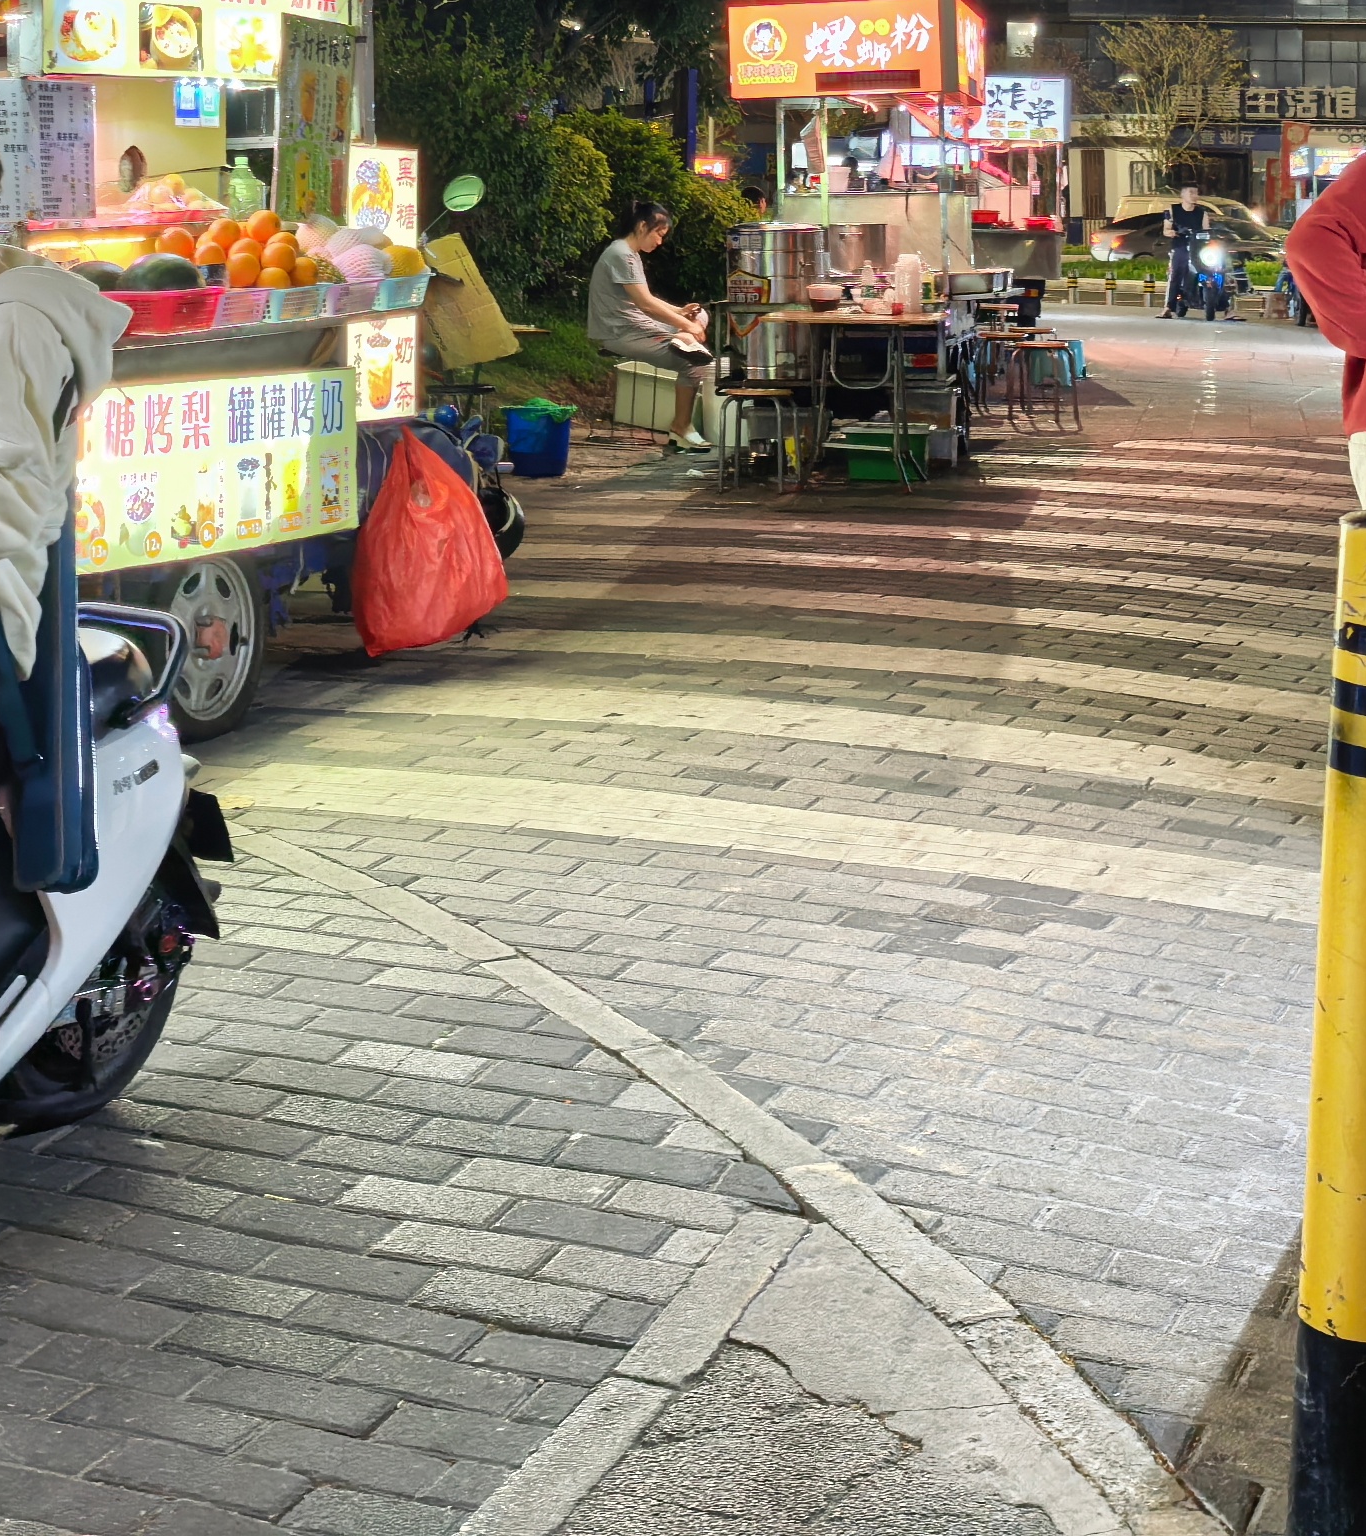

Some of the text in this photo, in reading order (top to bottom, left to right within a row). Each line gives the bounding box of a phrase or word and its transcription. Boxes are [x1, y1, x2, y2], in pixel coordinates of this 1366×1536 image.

[804, 12, 934, 69] 螺蛳粉
[1200, 130, 1255, 146] 营业厅
[228, 379, 344, 444] 罐罐烤奶
